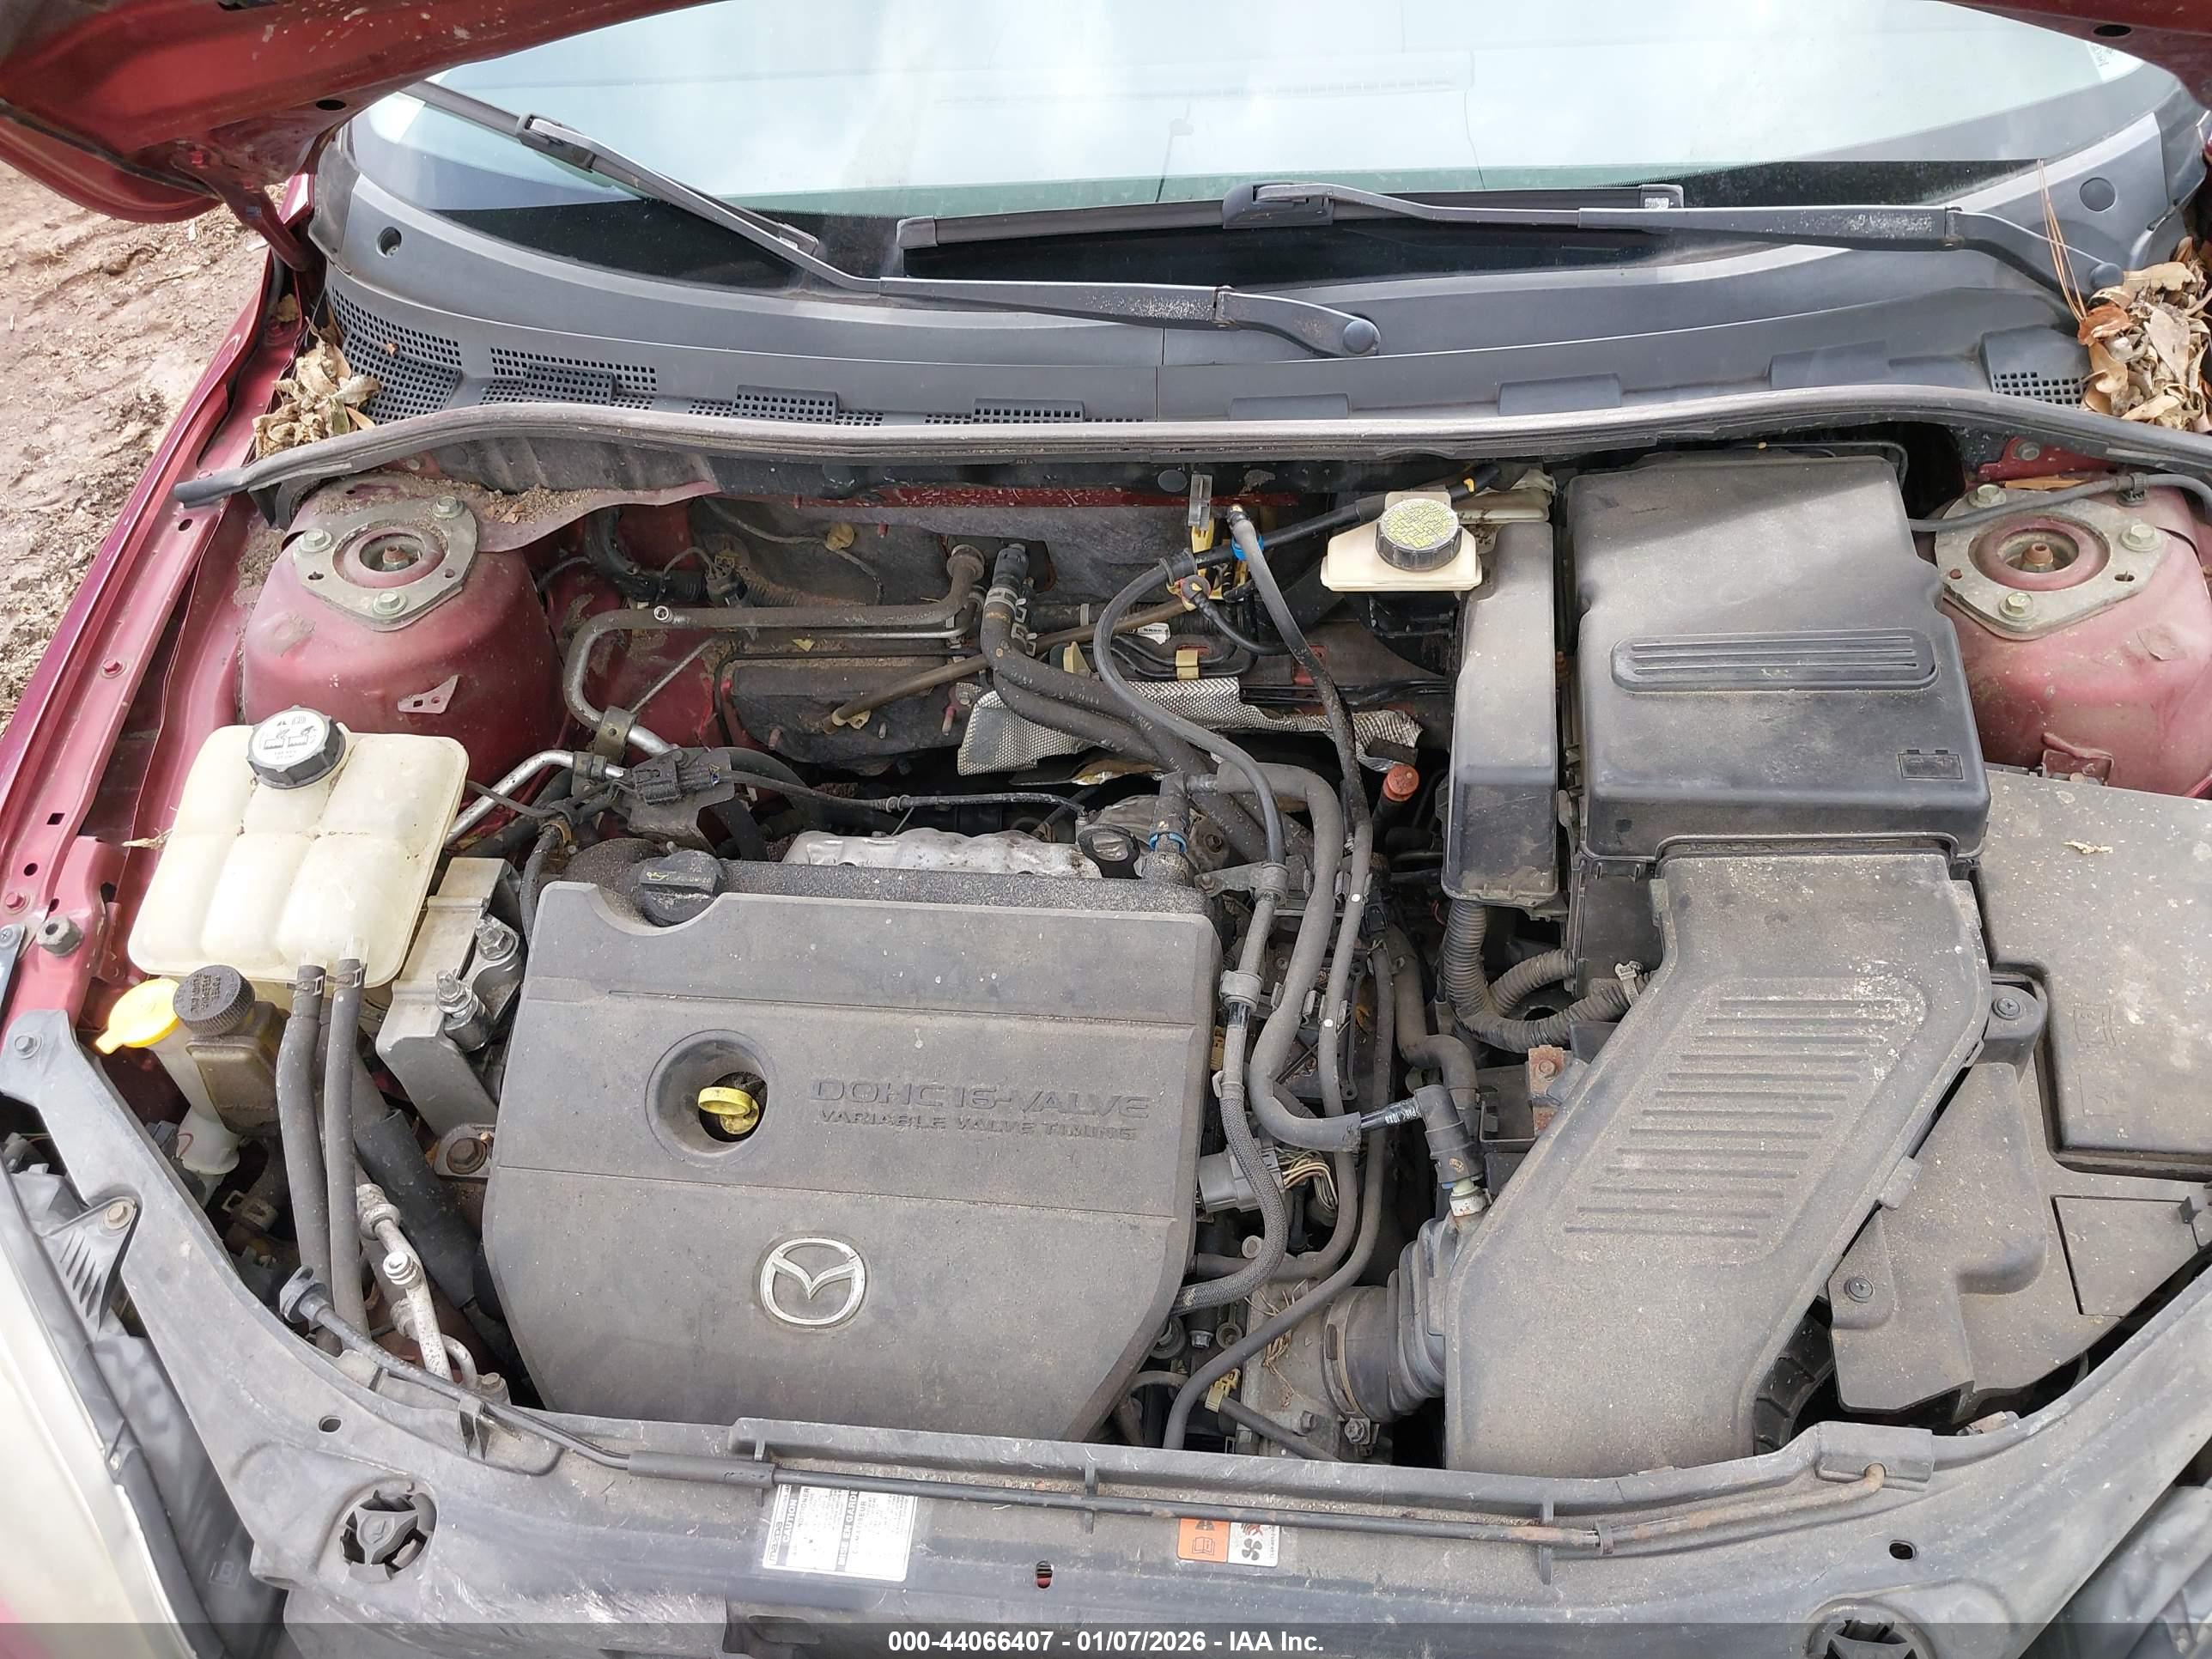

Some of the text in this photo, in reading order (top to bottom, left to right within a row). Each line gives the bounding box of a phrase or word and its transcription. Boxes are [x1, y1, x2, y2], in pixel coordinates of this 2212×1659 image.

[811, 1079, 1151, 1120] DOHC 16-VALVE
[820, 1109, 1138, 1142] VARIABLE VALVE TIMING
[782, 1498, 799, 1543] CAUTION
[842, 1524, 854, 1539] EN
